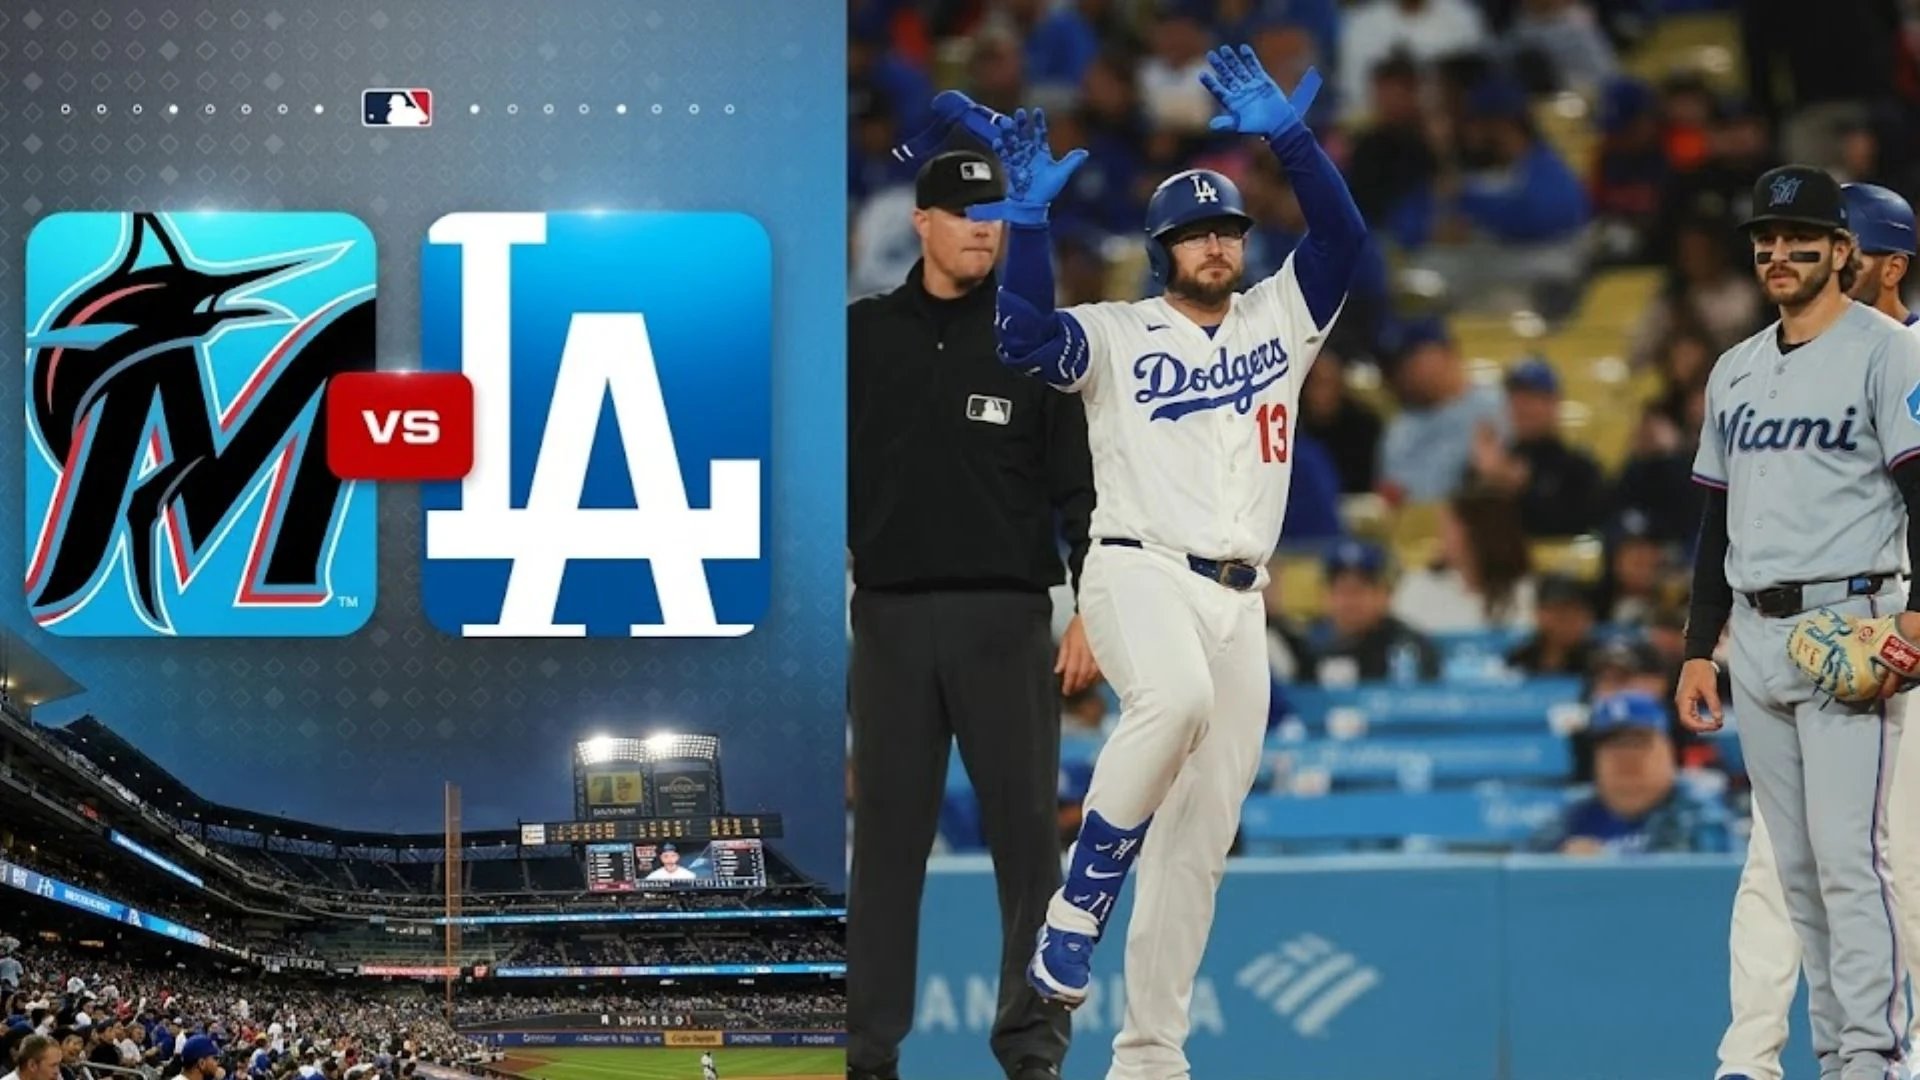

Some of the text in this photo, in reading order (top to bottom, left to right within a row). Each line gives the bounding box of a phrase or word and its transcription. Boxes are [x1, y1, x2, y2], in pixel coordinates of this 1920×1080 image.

[1190, 175, 1219, 204] LA
[1133, 336, 1289, 416] Dodgers
[1255, 402, 1288, 464] 13
[1718, 401, 1858, 457] Miami
